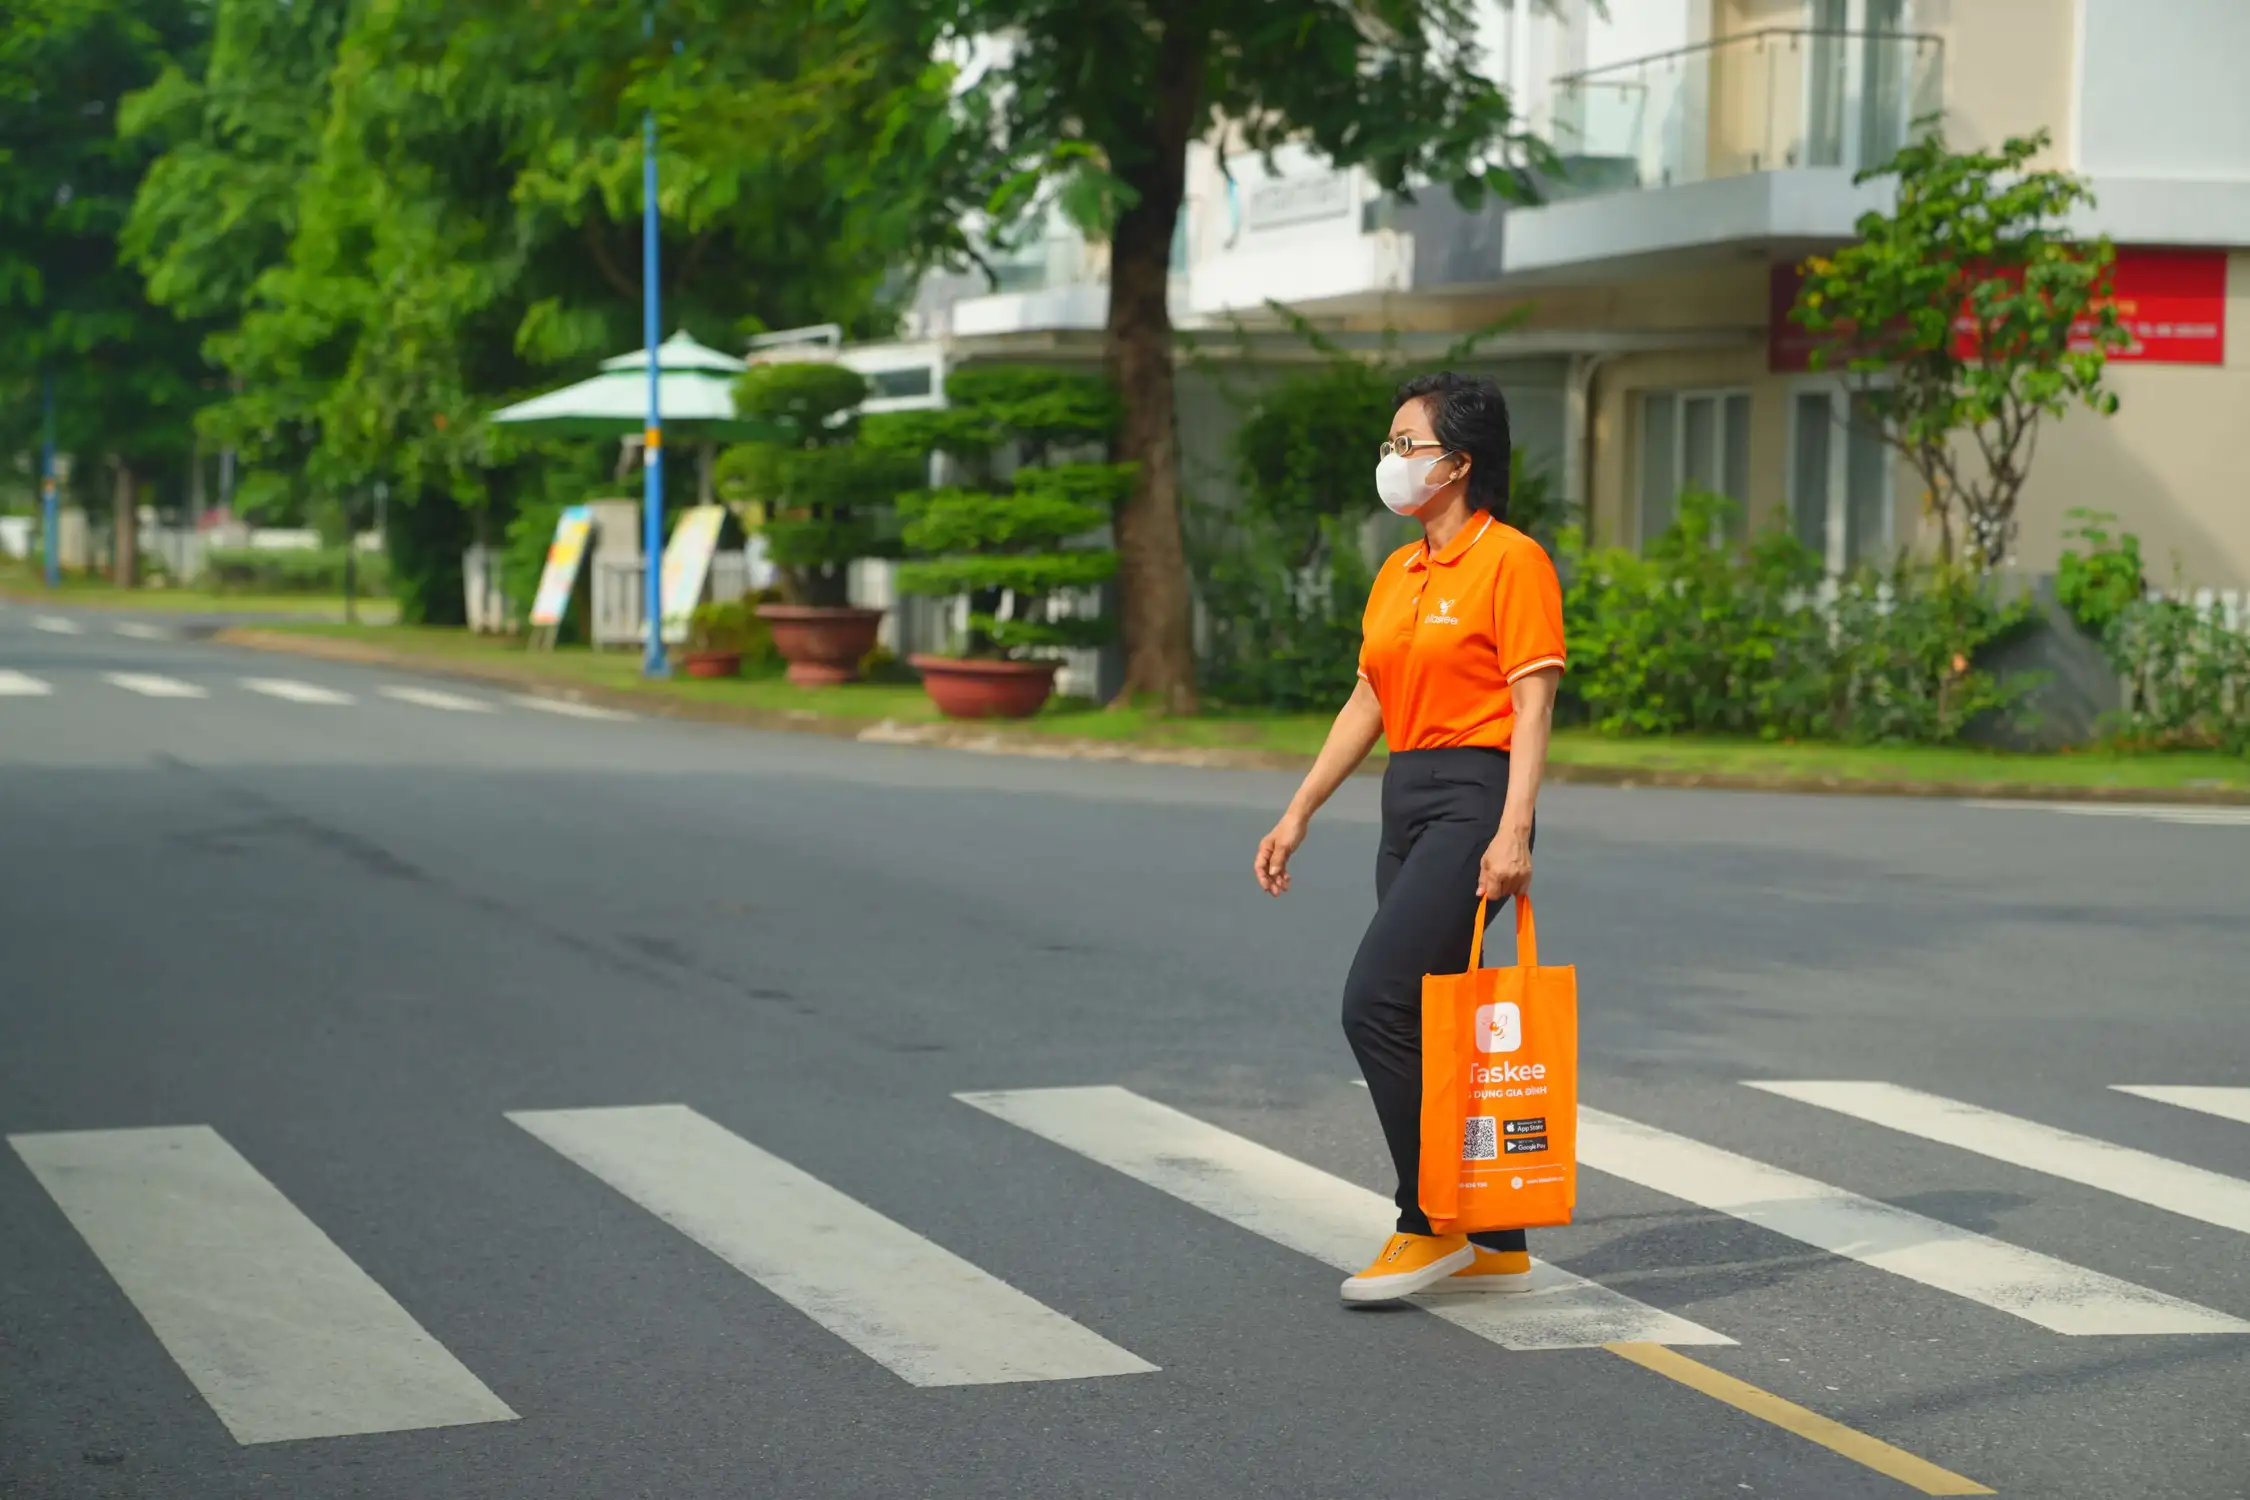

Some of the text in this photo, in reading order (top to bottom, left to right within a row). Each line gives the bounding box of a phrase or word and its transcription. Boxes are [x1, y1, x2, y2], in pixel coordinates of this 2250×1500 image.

[1470, 1060, 1546, 1084] Taskee
[1474, 1089, 1503, 1100] DỤNG
[1506, 1088, 1523, 1098] GIA
[1517, 1125, 1530, 1133] App
[1518, 1143, 1536, 1151] Google
